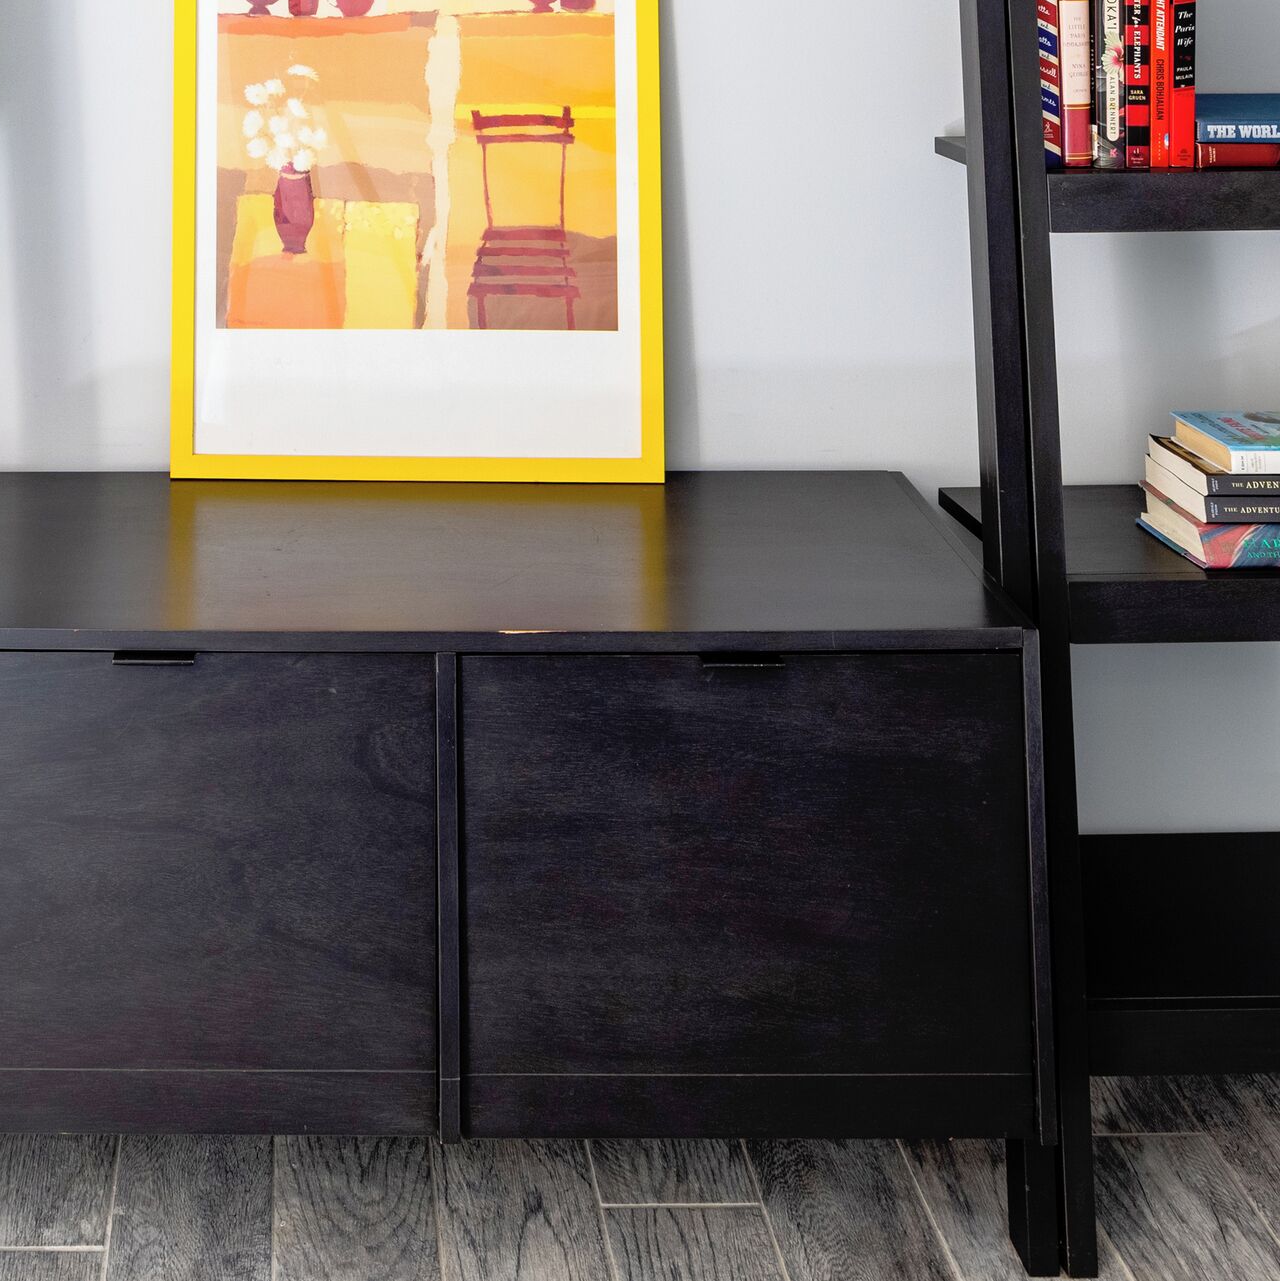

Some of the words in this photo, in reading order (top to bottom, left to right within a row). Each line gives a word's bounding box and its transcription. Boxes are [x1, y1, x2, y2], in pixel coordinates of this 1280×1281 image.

[1178, 11, 1193, 20] The
[1156, 9, 1165, 51] ATTENDANT
[1175, 24, 1195, 33] Paris
[1177, 37, 1193, 47] Wife
[1133, 30, 1141, 79] ELEPHANTS
[1156, 58, 1164, 80] CHRIS
[1156, 81, 1164, 120] BOHJALIAN
[1207, 125, 1236, 138] THE
